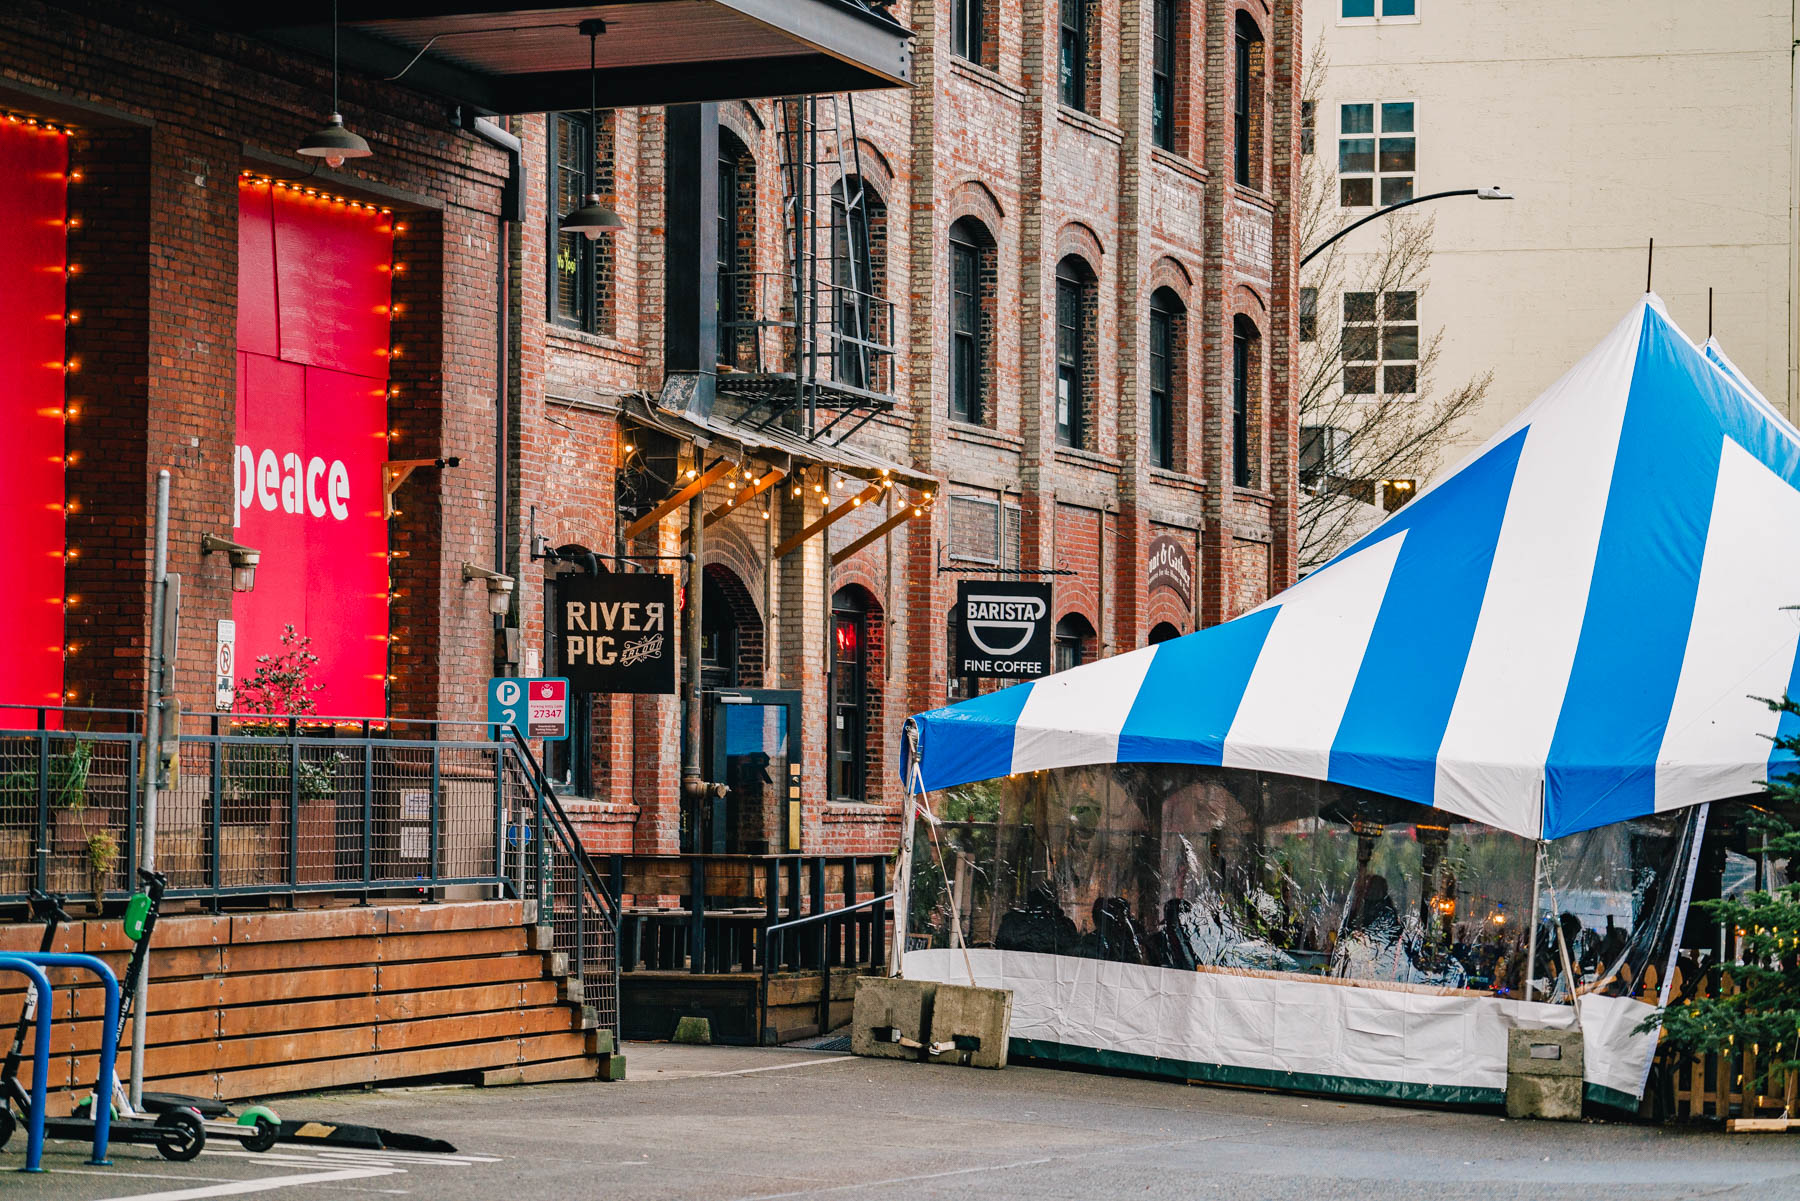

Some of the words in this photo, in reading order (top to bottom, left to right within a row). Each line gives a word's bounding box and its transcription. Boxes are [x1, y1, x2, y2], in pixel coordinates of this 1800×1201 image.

[233, 445, 350, 528] peace
[1149, 551, 1160, 573] unt
[967, 602, 1035, 620] BARISTA
[567, 635, 618, 665] PIG
[621, 638, 663, 661] SALOON
[964, 659, 992, 672] FINE
[994, 660, 1042, 674] COFFEE
[503, 684, 516, 703] P
[502, 709, 516, 731] 2
[533, 709, 562, 719] 27347
